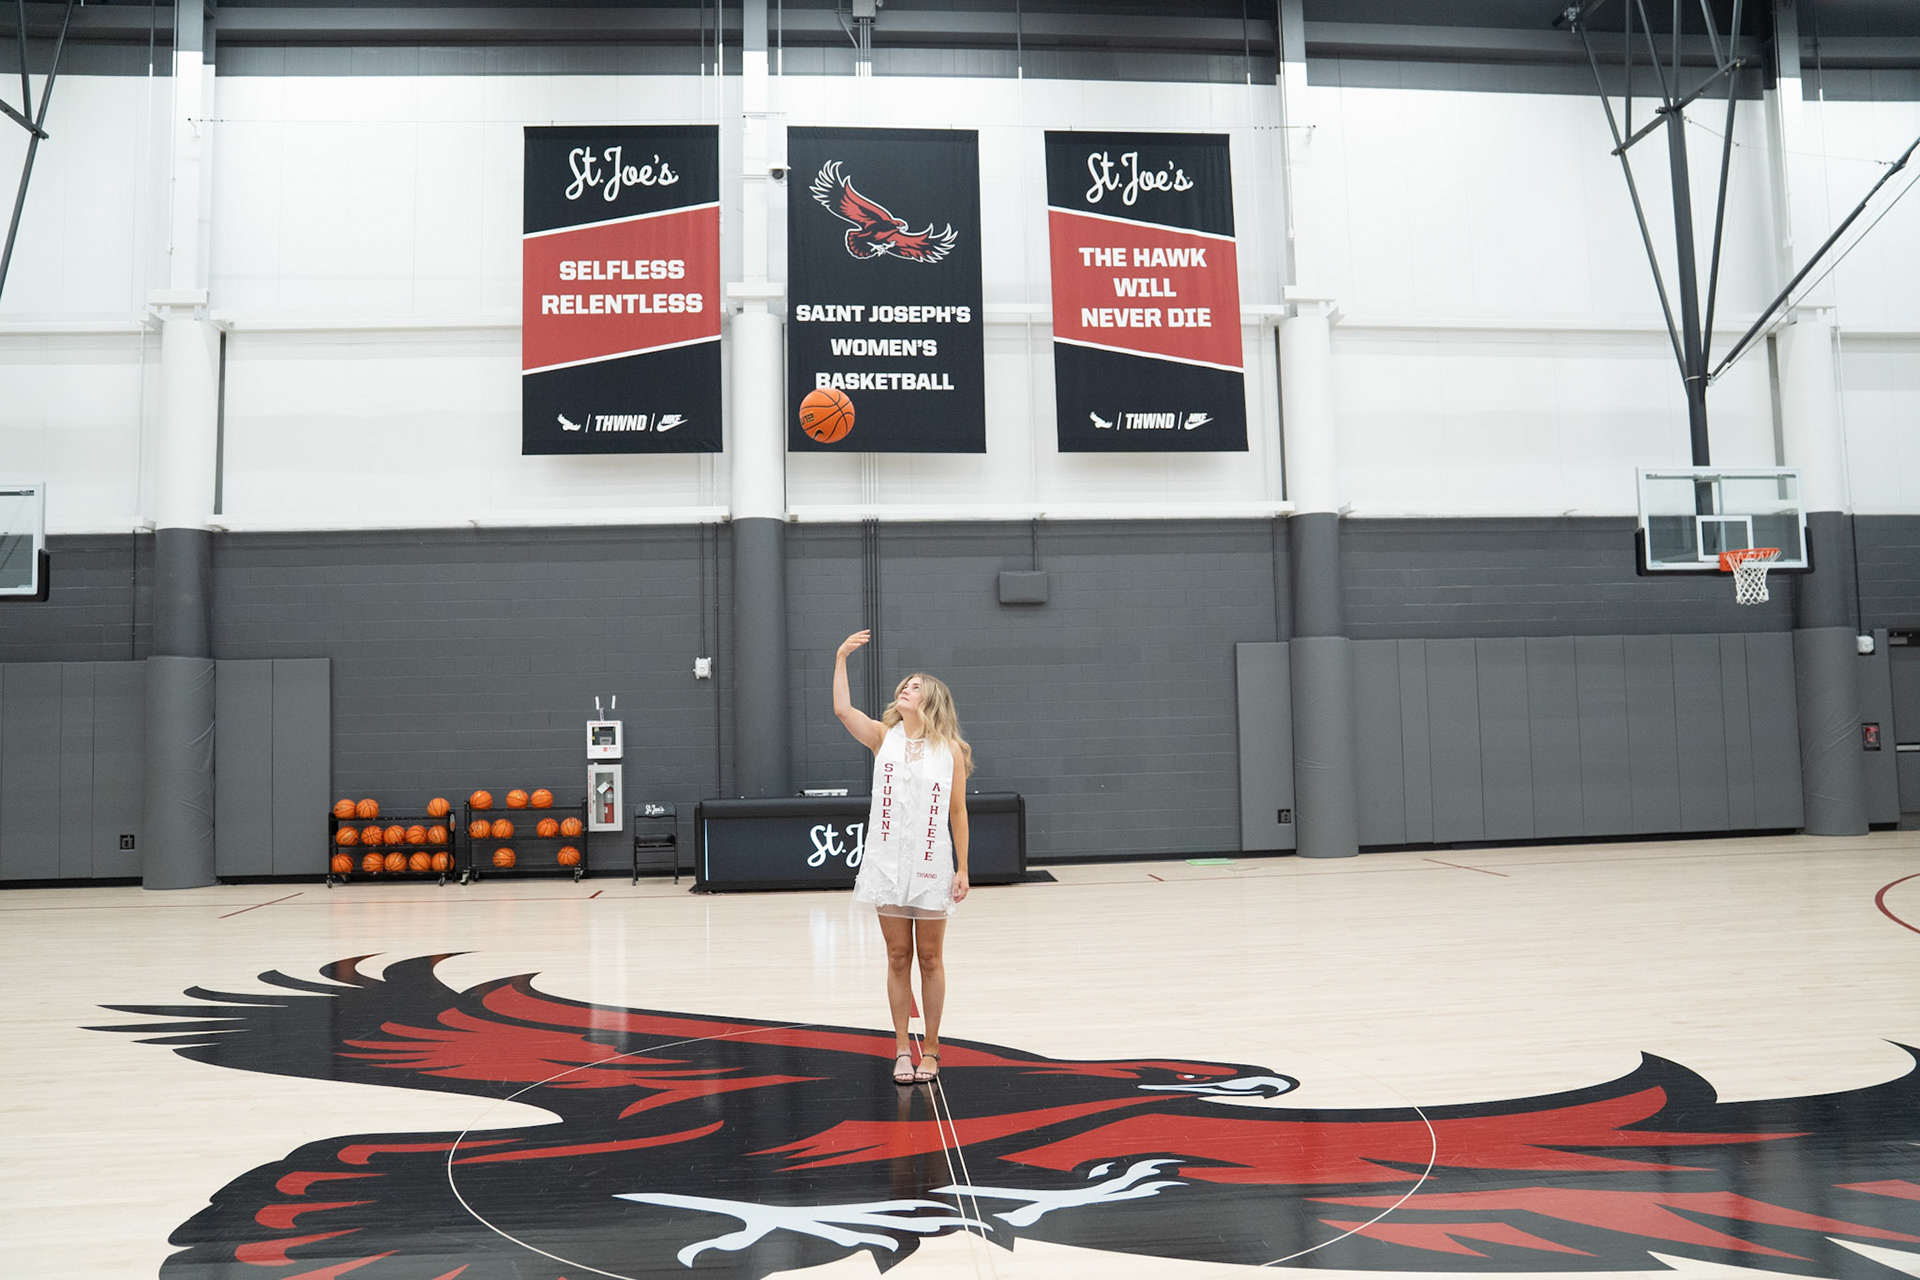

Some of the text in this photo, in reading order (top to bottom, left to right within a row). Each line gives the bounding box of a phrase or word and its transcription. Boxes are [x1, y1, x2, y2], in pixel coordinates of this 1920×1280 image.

[565, 146, 679, 202] St. Joe's
[1086, 151, 1194, 206] St. Joe's
[1079, 247, 1207, 267] THE HAWK
[559, 260, 685, 280] SELFLESS
[1113, 278, 1177, 297] WILL
[542, 293, 703, 314] RELENTLESS
[796, 305, 971, 323] SAINT JOSEPH'S
[1081, 308, 1212, 327] NEVER DIE
[831, 339, 938, 356] WOMEN'S
[815, 373, 954, 390] BASKETBALL
[595, 414, 648, 431] THWND
[1125, 412, 1175, 429] THWND
[881, 763, 894, 841] STUDENT
[924, 782, 941, 861] ATHLETE
[807, 823, 847, 867] St.
